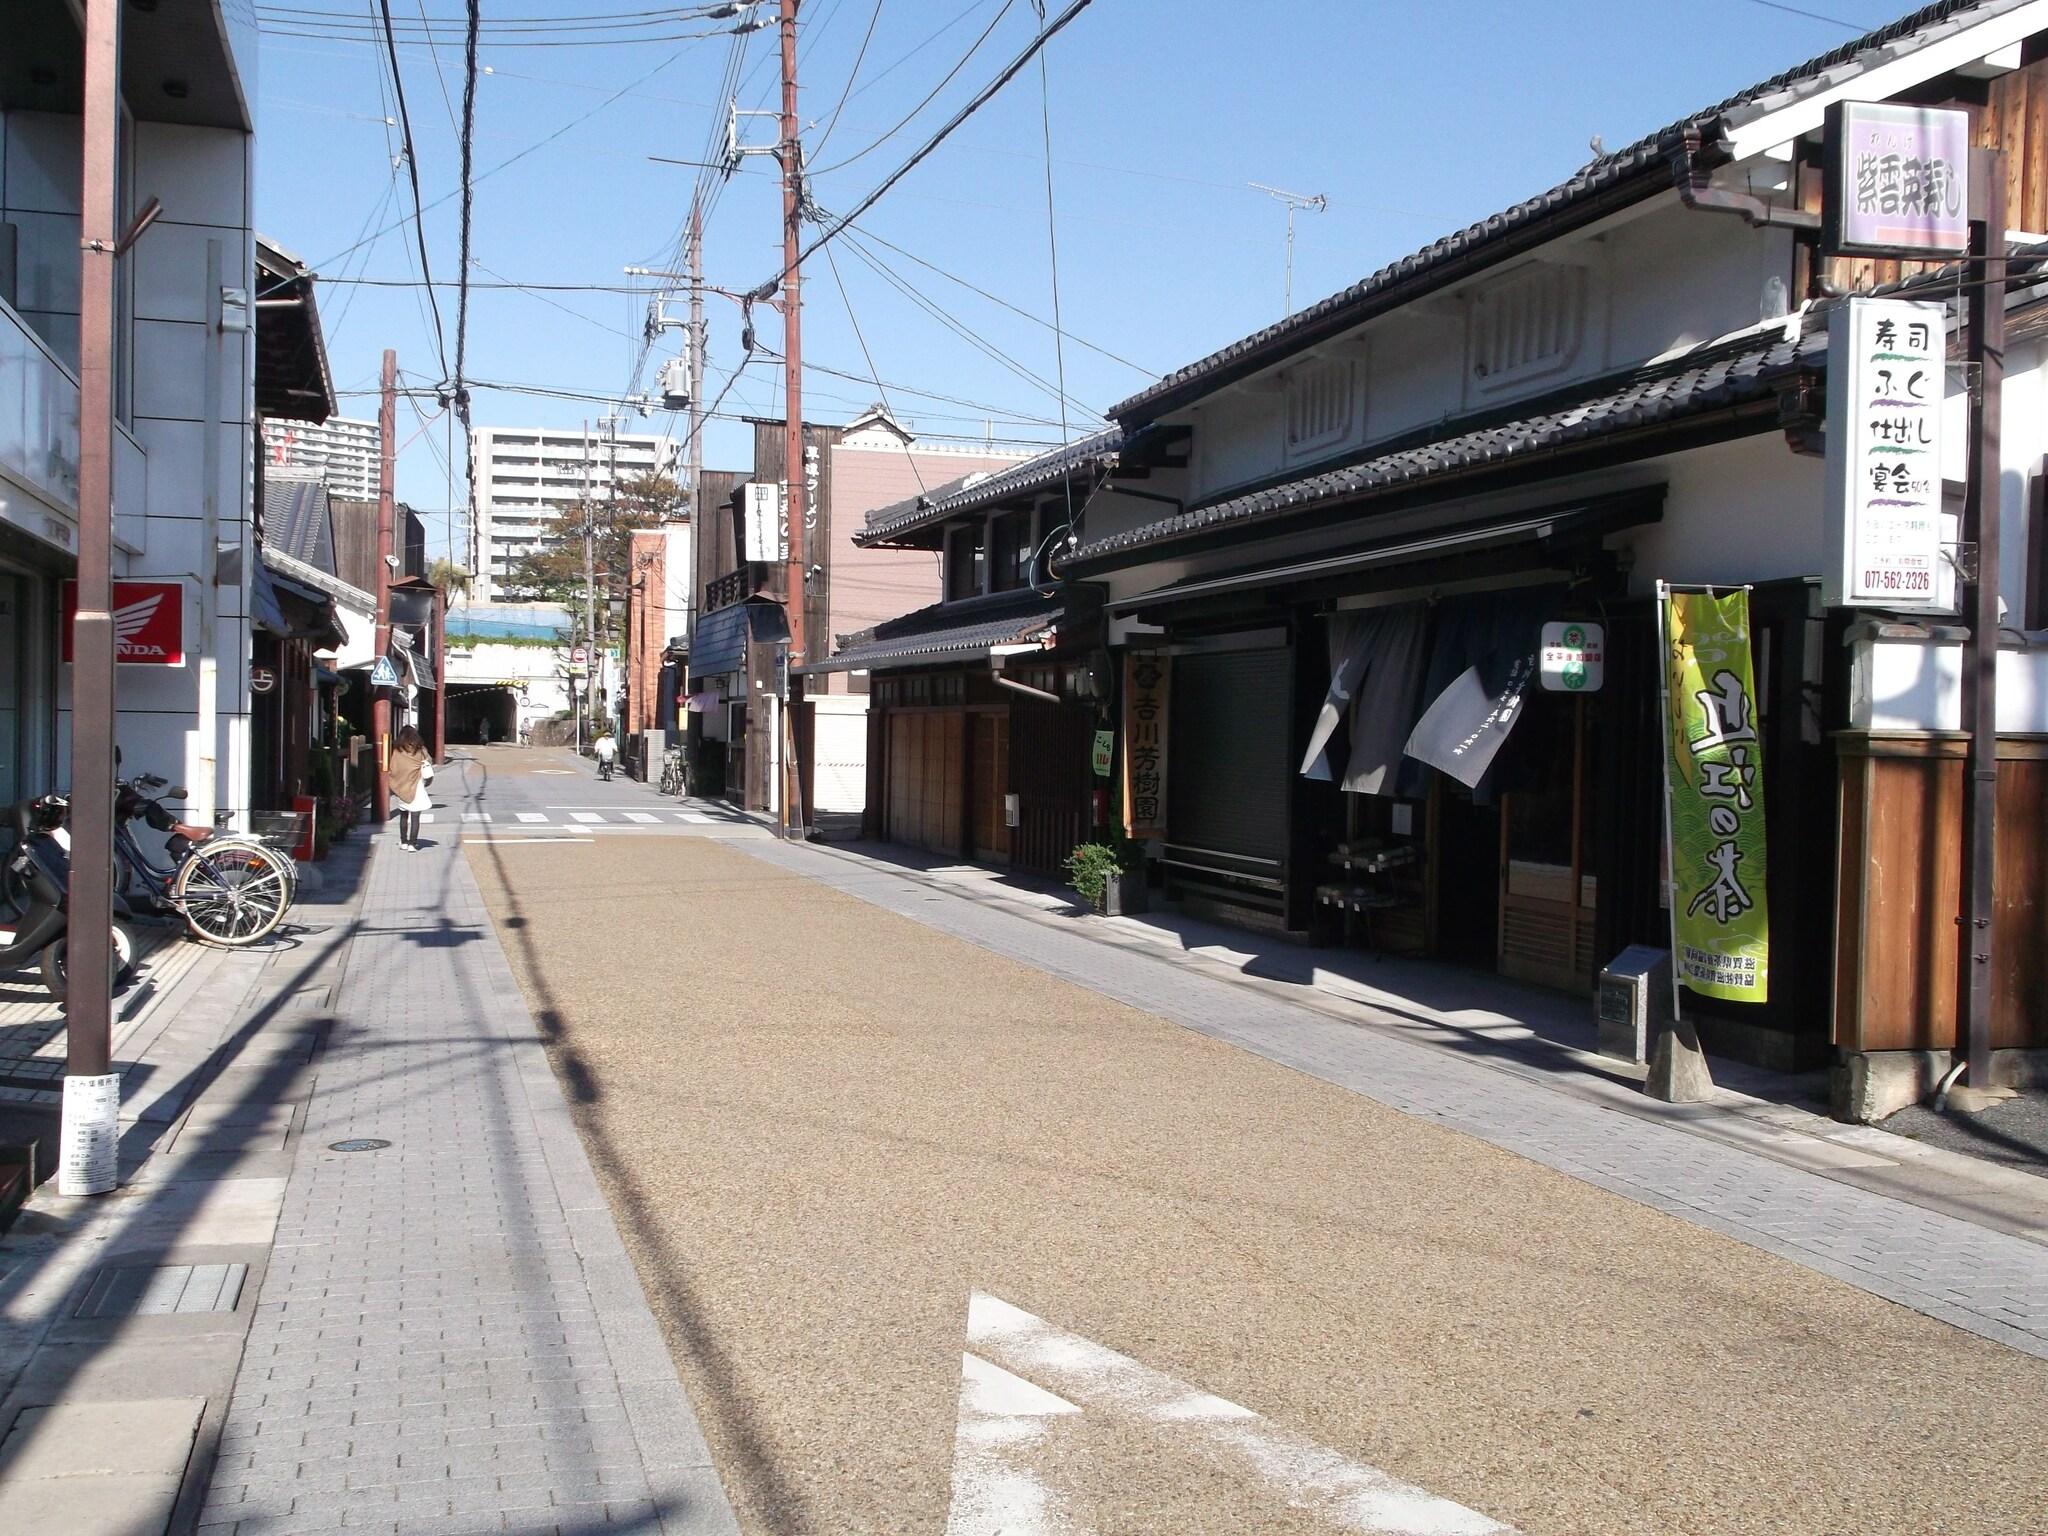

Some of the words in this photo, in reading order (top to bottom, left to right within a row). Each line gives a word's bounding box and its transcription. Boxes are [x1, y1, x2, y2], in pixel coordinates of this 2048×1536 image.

[1857, 152, 1961, 218] 紫雲英寿し
[1876, 318, 1929, 351] 寿司
[1870, 416, 1932, 444] 仕出し
[1865, 571, 1929, 590] 077-562-2326
[116, 645, 166, 655] NDA
[1133, 696, 1162, 820] 吉川芳樹園
